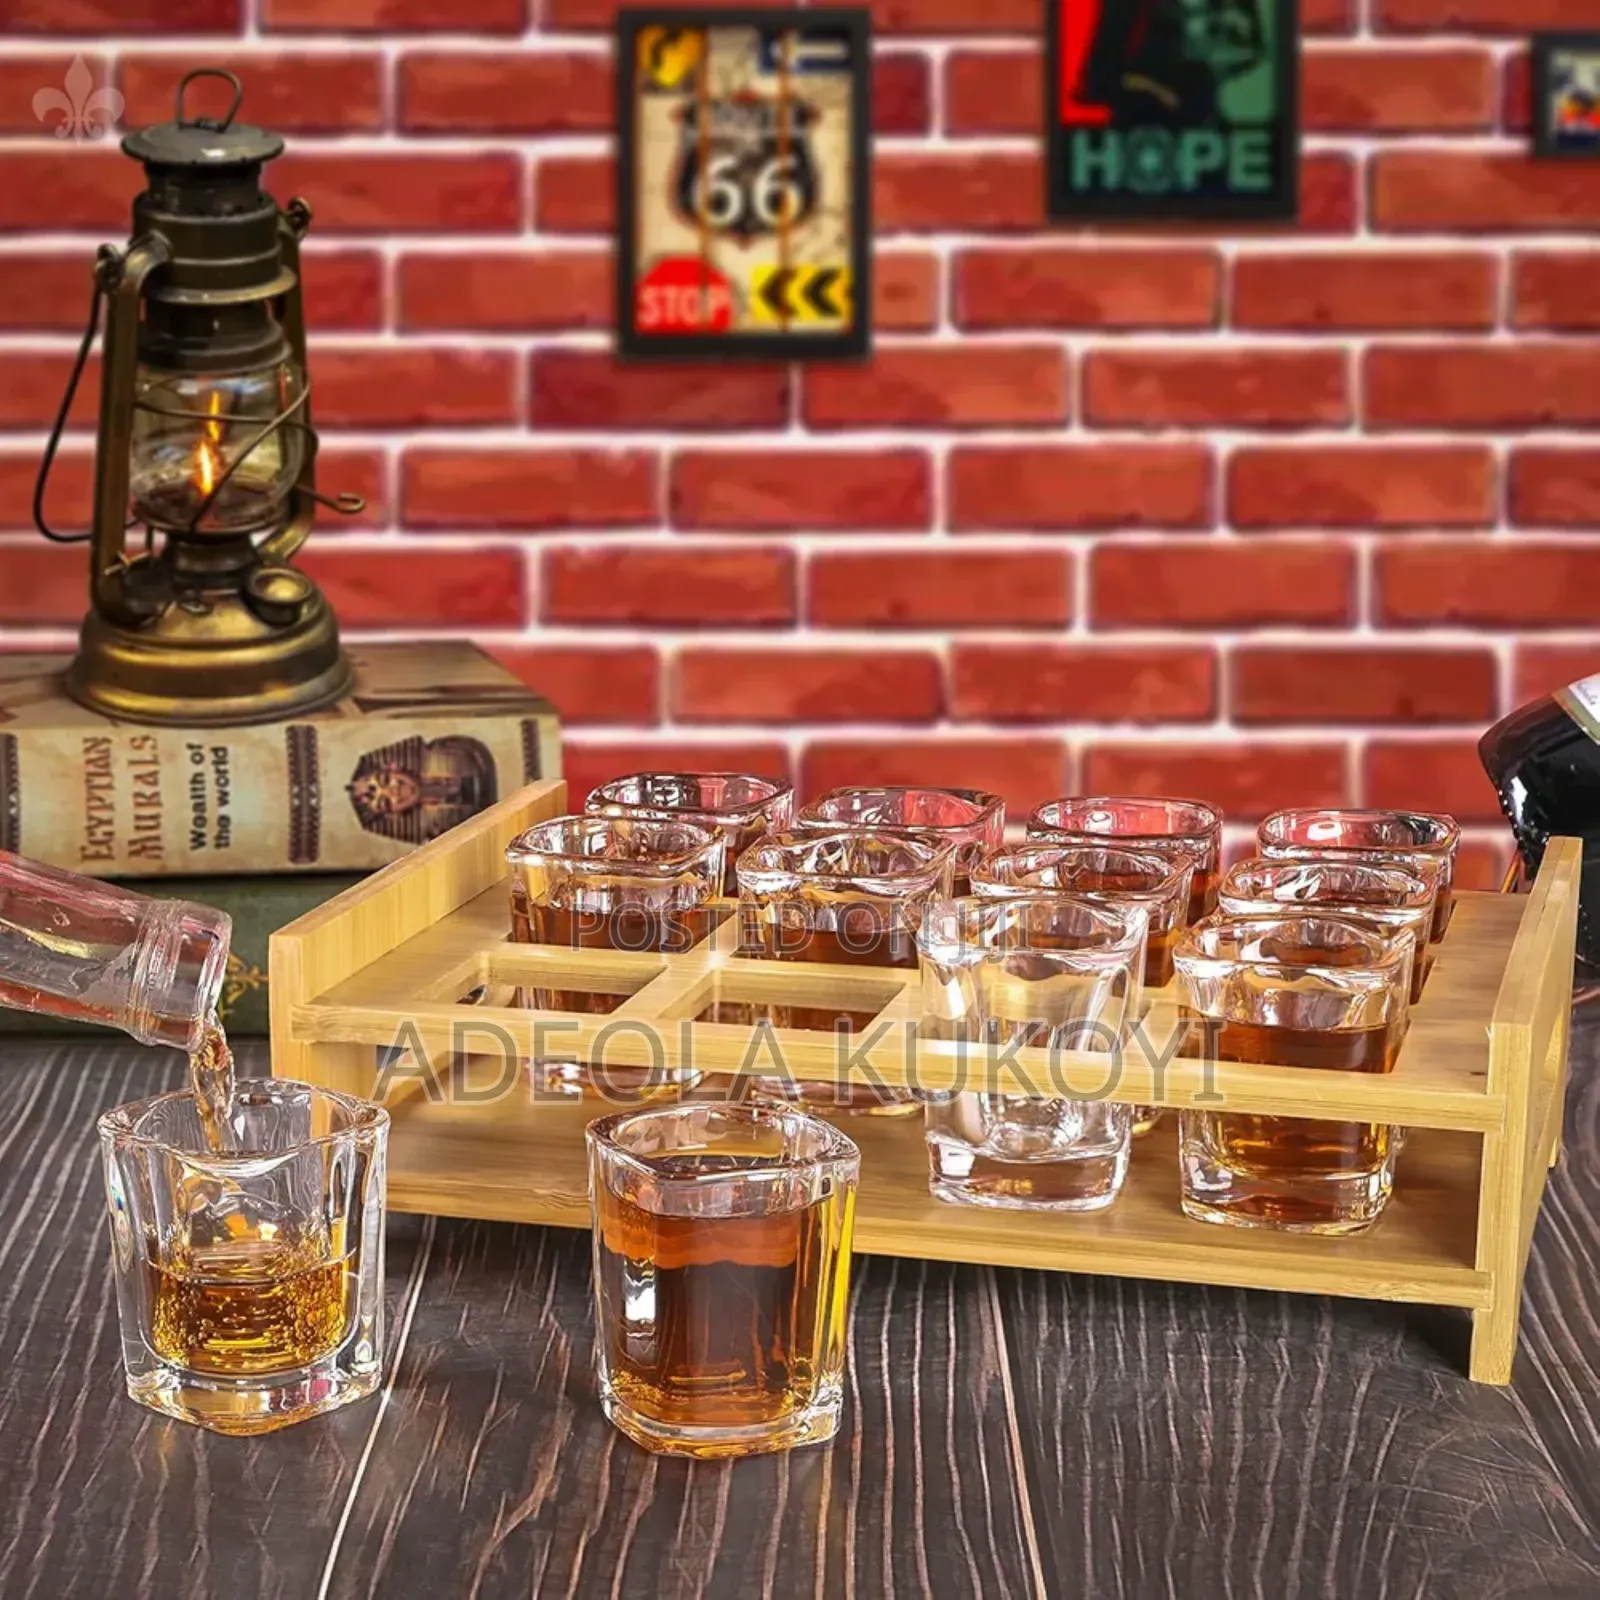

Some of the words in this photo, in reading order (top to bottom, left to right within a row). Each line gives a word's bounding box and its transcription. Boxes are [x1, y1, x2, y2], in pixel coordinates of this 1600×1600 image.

[692, 155, 802, 226] 66
[1072, 128, 1272, 192] HOPE
[638, 285, 730, 326] STOP
[186, 742, 205, 766] of
[210, 746, 230, 807] world
[80, 736, 116, 862] EGYPTIAN
[127, 734, 164, 860] MURALS
[214, 815, 231, 850] the
